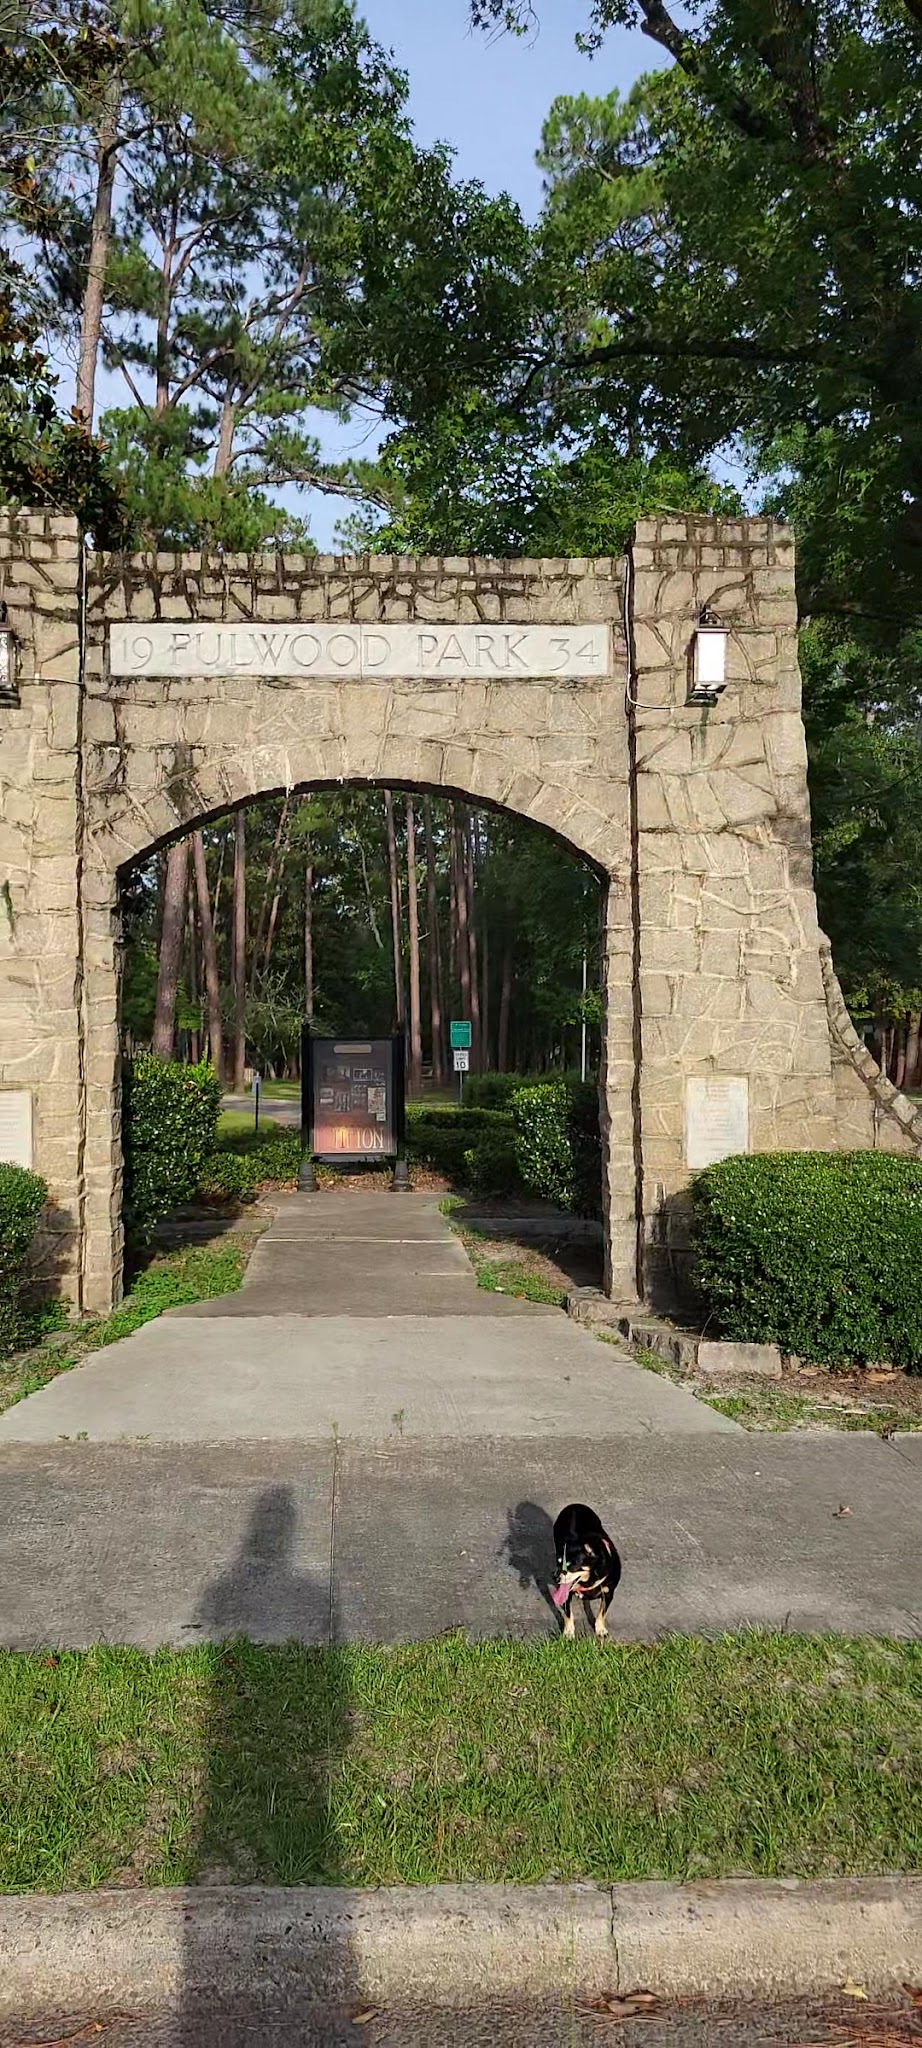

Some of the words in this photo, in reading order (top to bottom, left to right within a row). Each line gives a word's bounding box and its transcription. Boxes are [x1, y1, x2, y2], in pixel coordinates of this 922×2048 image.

[122, 636, 153, 669] 19
[170, 633, 392, 667] FULWOOD
[416, 634, 531, 668] PARK
[548, 638, 600, 671] 34
